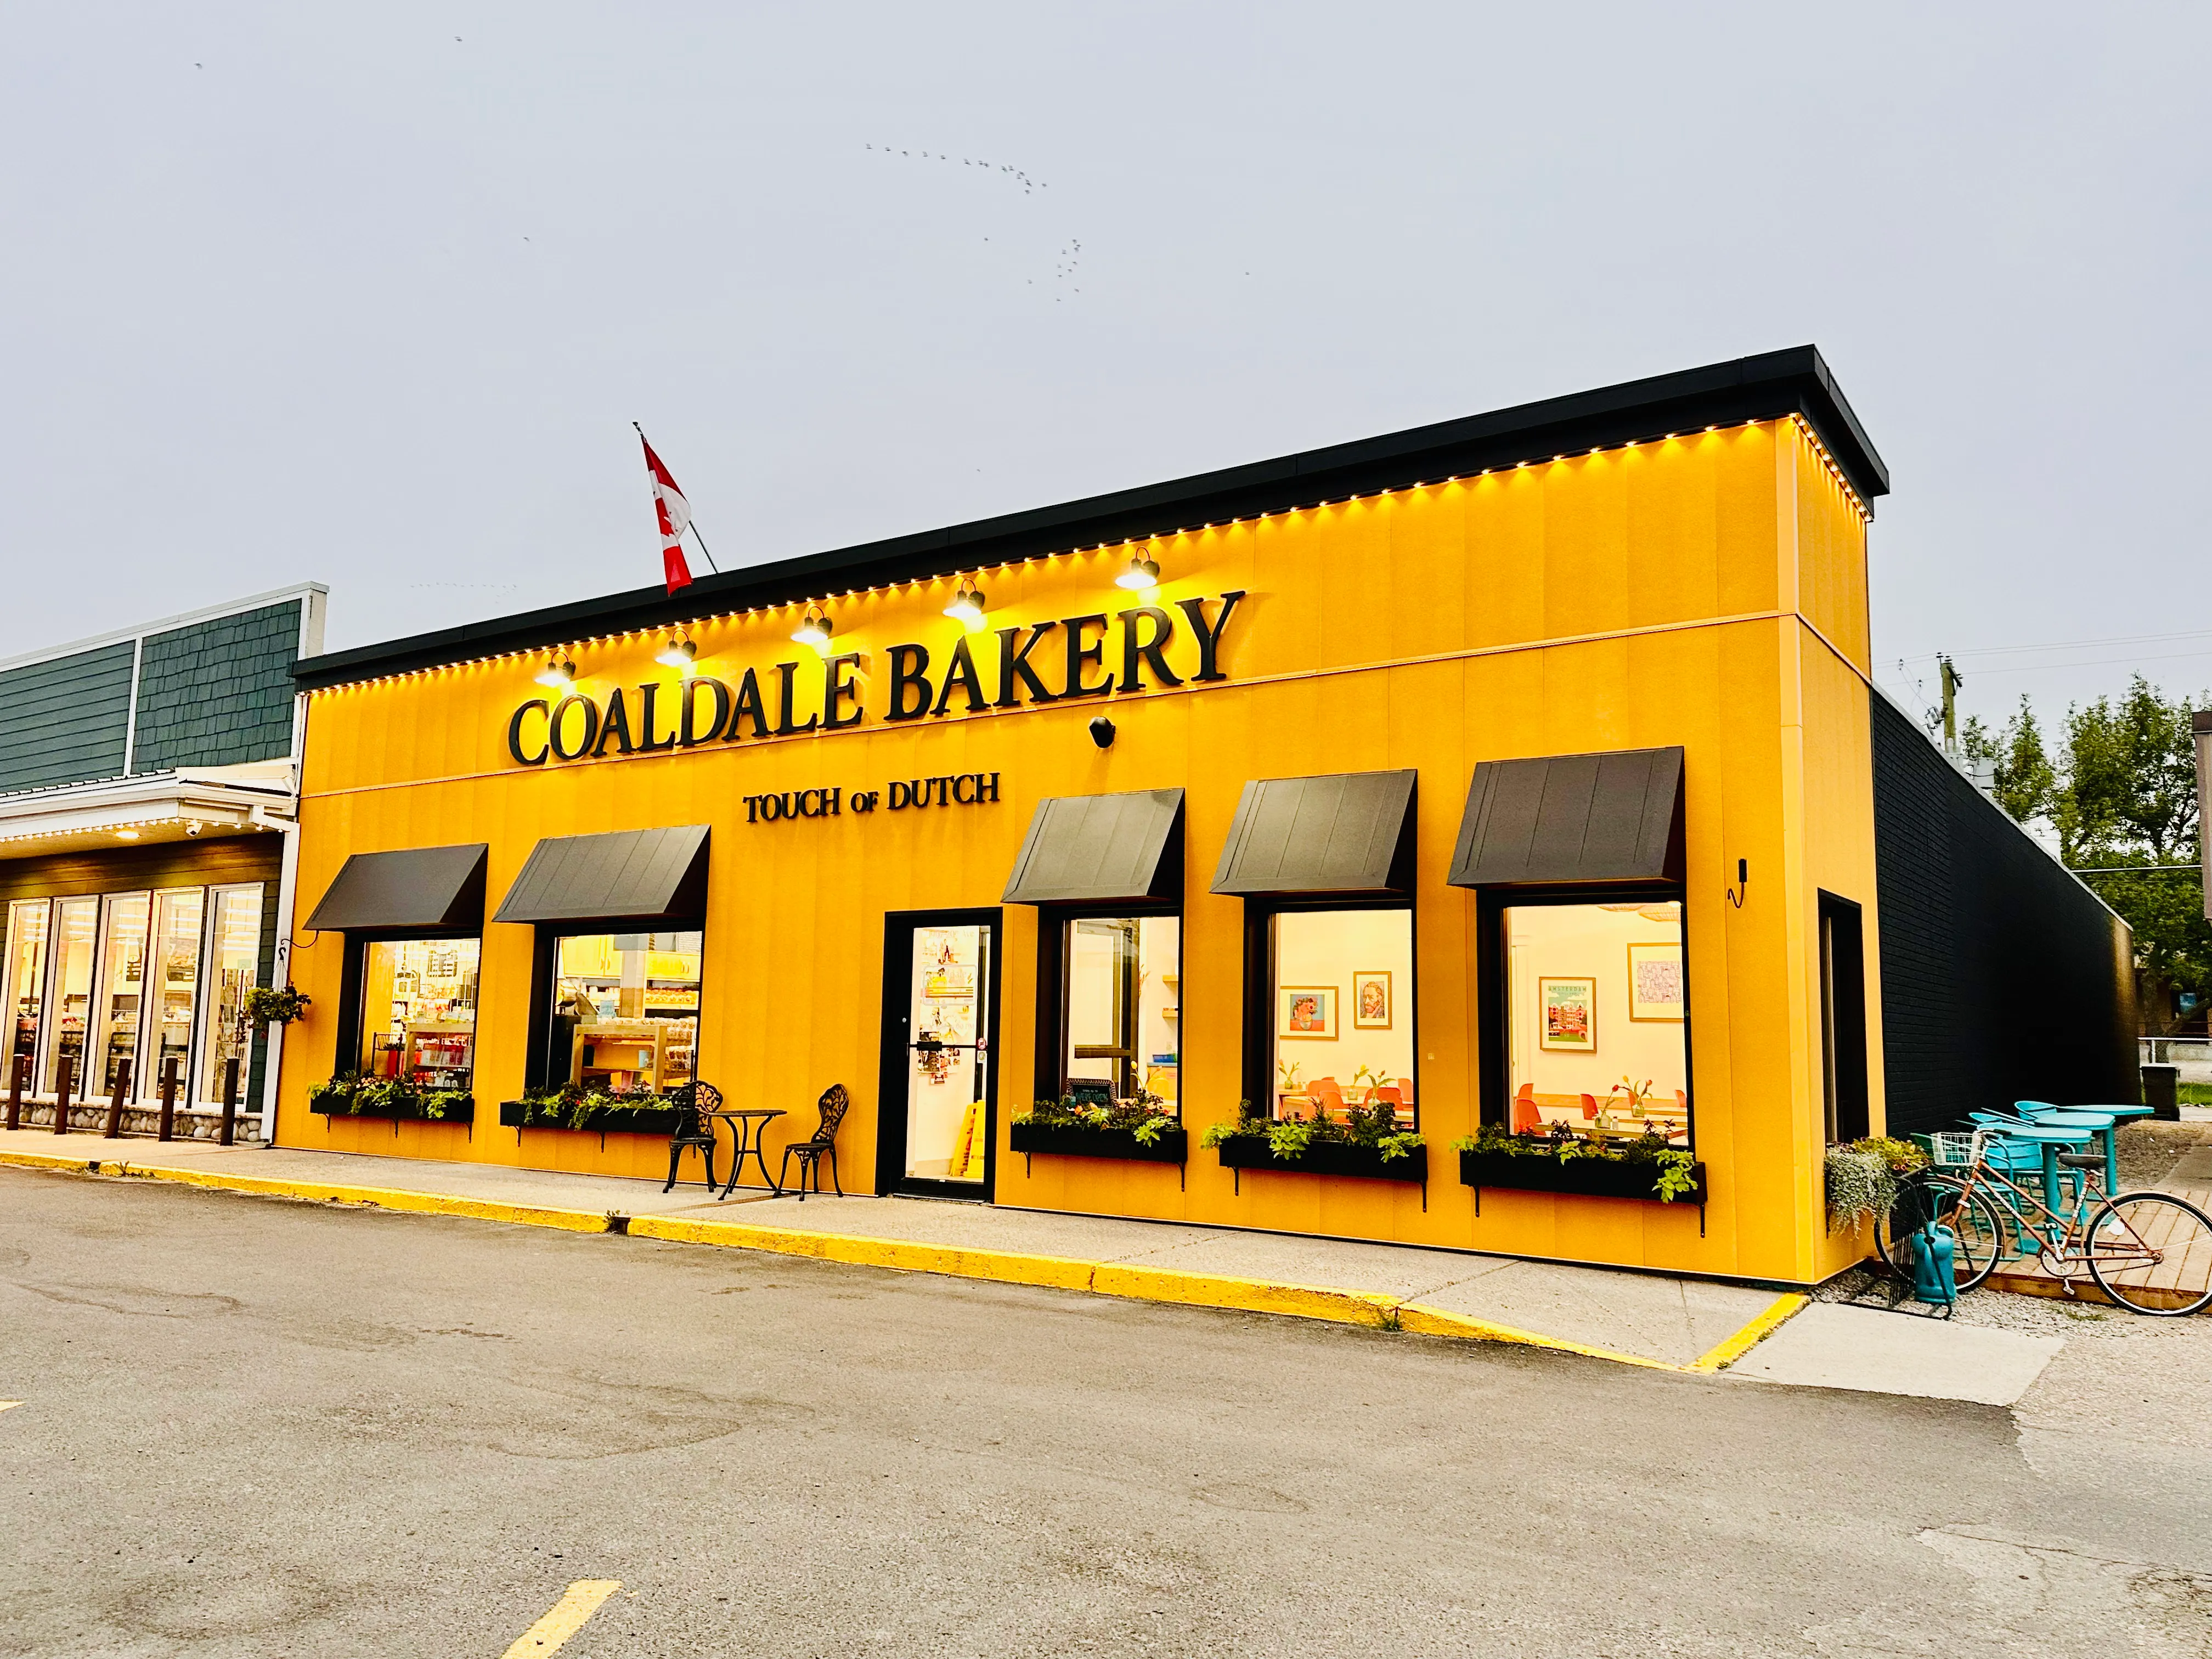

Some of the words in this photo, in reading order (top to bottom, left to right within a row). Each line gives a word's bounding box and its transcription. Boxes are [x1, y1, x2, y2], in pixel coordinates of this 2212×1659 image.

[509, 652, 864, 765] COALDALE
[883, 590, 1246, 721] BAKERY
[742, 787, 842, 823] TOUCH
[850, 791, 879, 813] OF
[887, 772, 1001, 811] DUTCH
